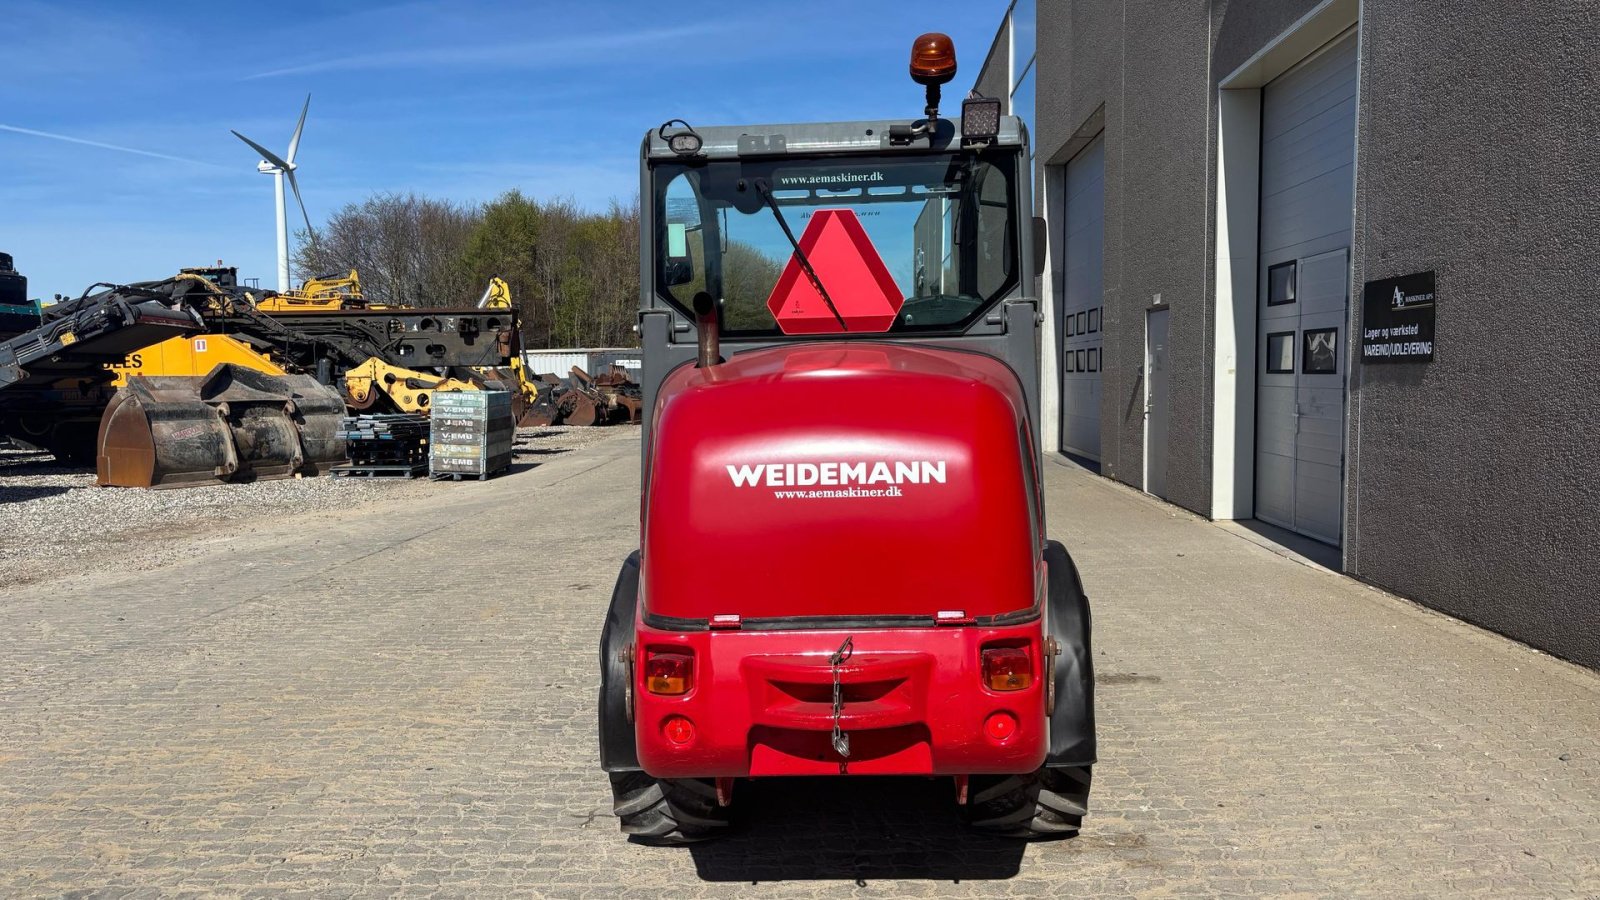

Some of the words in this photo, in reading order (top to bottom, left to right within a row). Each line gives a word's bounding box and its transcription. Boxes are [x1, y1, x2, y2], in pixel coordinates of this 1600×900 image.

[781, 172, 884, 185] www.aemaskiner.dk
[1364, 328, 1381, 340] Lager
[1382, 328, 1389, 339] og
[1390, 323, 1419, 336] værksted
[1363, 341, 1432, 357] VAREIND/UDLEVERING
[442, 458, 473, 466] V-EMB
[726, 460, 947, 487] WEIDEMANN
[774, 486, 903, 499] www.aemaskiner.dk
